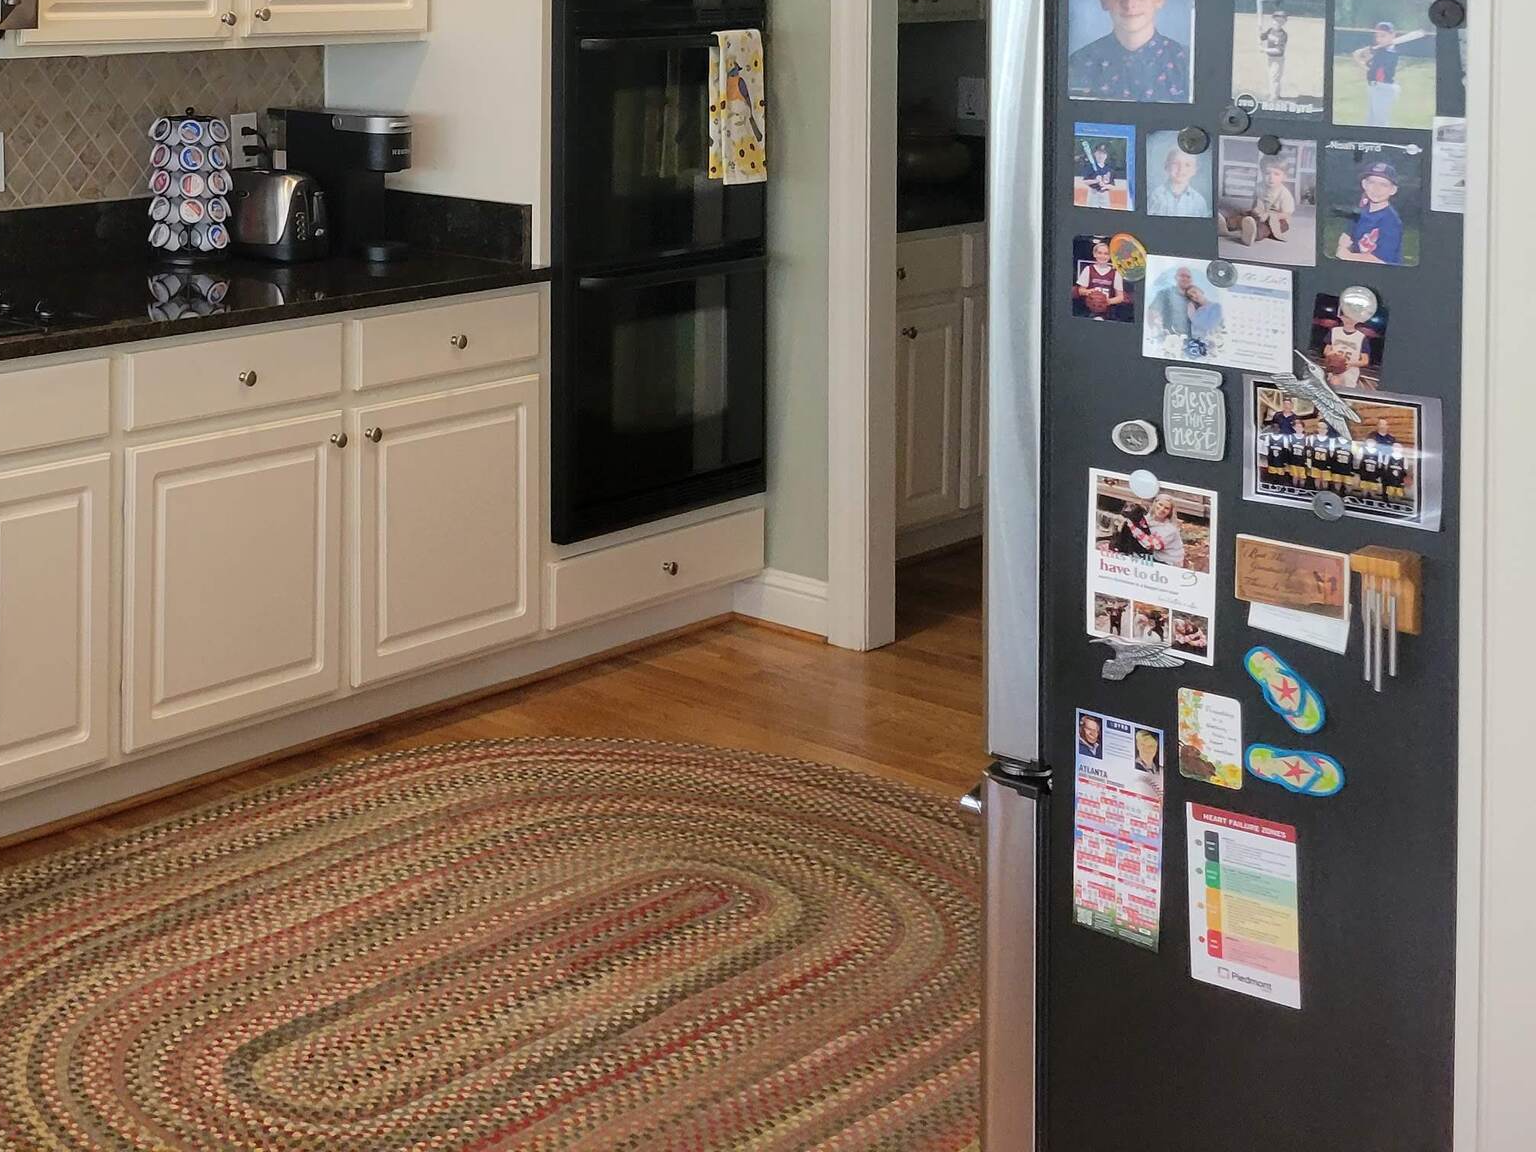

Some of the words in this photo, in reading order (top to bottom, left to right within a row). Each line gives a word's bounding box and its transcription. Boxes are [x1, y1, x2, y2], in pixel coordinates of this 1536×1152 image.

[1172, 427, 1217, 450] nest
[1100, 558, 1131, 576] have
[1133, 566, 1148, 579] to
[1150, 570, 1169, 585] do
[1079, 764, 1108, 778] ATLANTA
[1203, 813, 1227, 825] HEART
[1228, 818, 1260, 833] FAILURE
[1231, 971, 1272, 991] Piedmont
